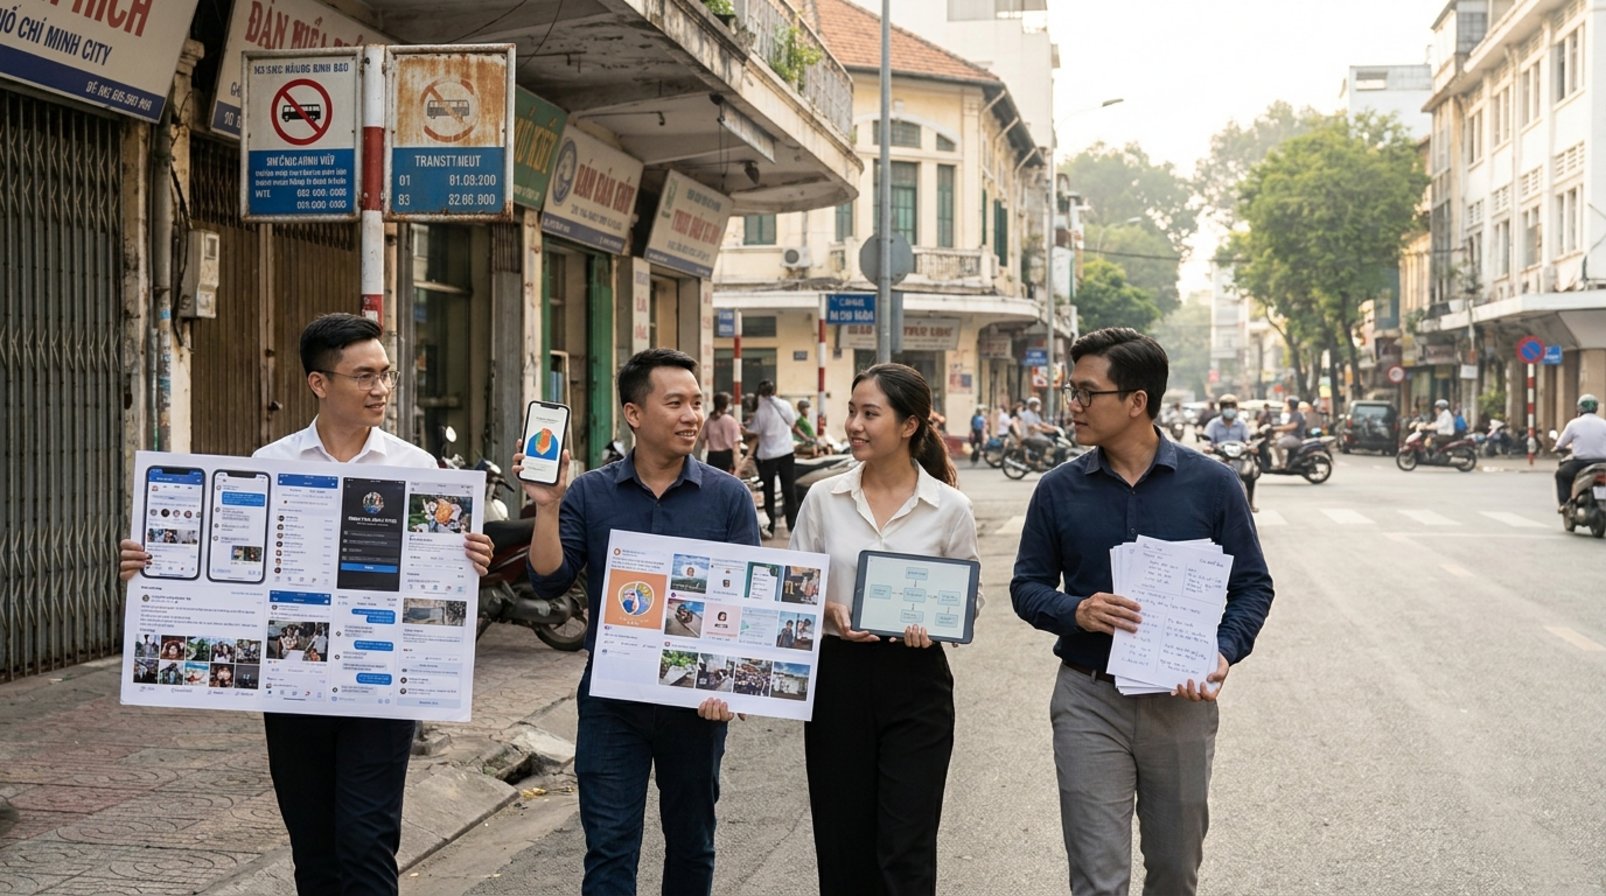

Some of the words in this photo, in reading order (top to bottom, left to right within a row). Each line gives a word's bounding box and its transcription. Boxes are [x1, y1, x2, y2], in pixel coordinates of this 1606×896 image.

[18, 16, 48, 43] CHÍ
[44, 25, 82, 55] MINH
[82, 39, 113, 66] CITY
